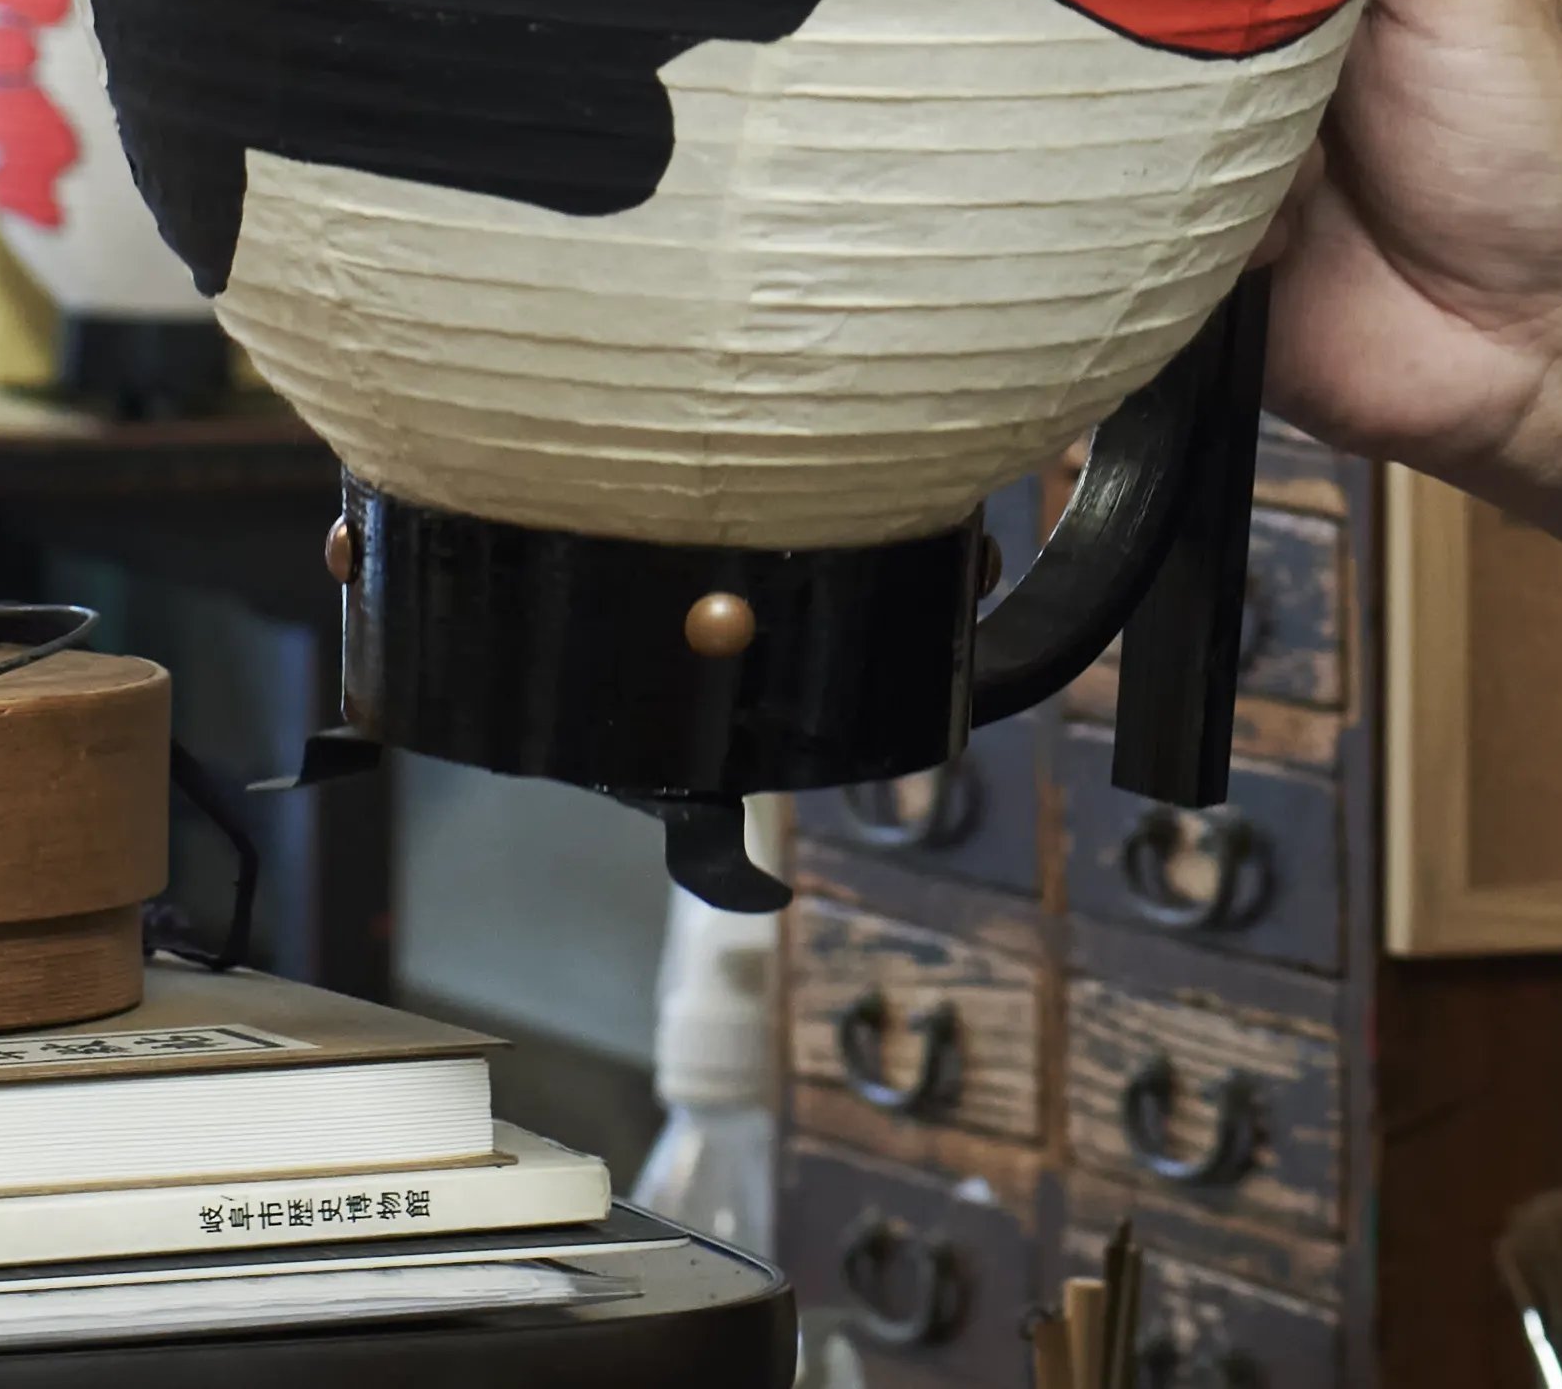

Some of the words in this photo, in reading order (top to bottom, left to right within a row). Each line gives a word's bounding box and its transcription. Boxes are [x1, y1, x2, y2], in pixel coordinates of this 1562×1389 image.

[198, 1190, 431, 1233] 岐阜市歴史博物館
